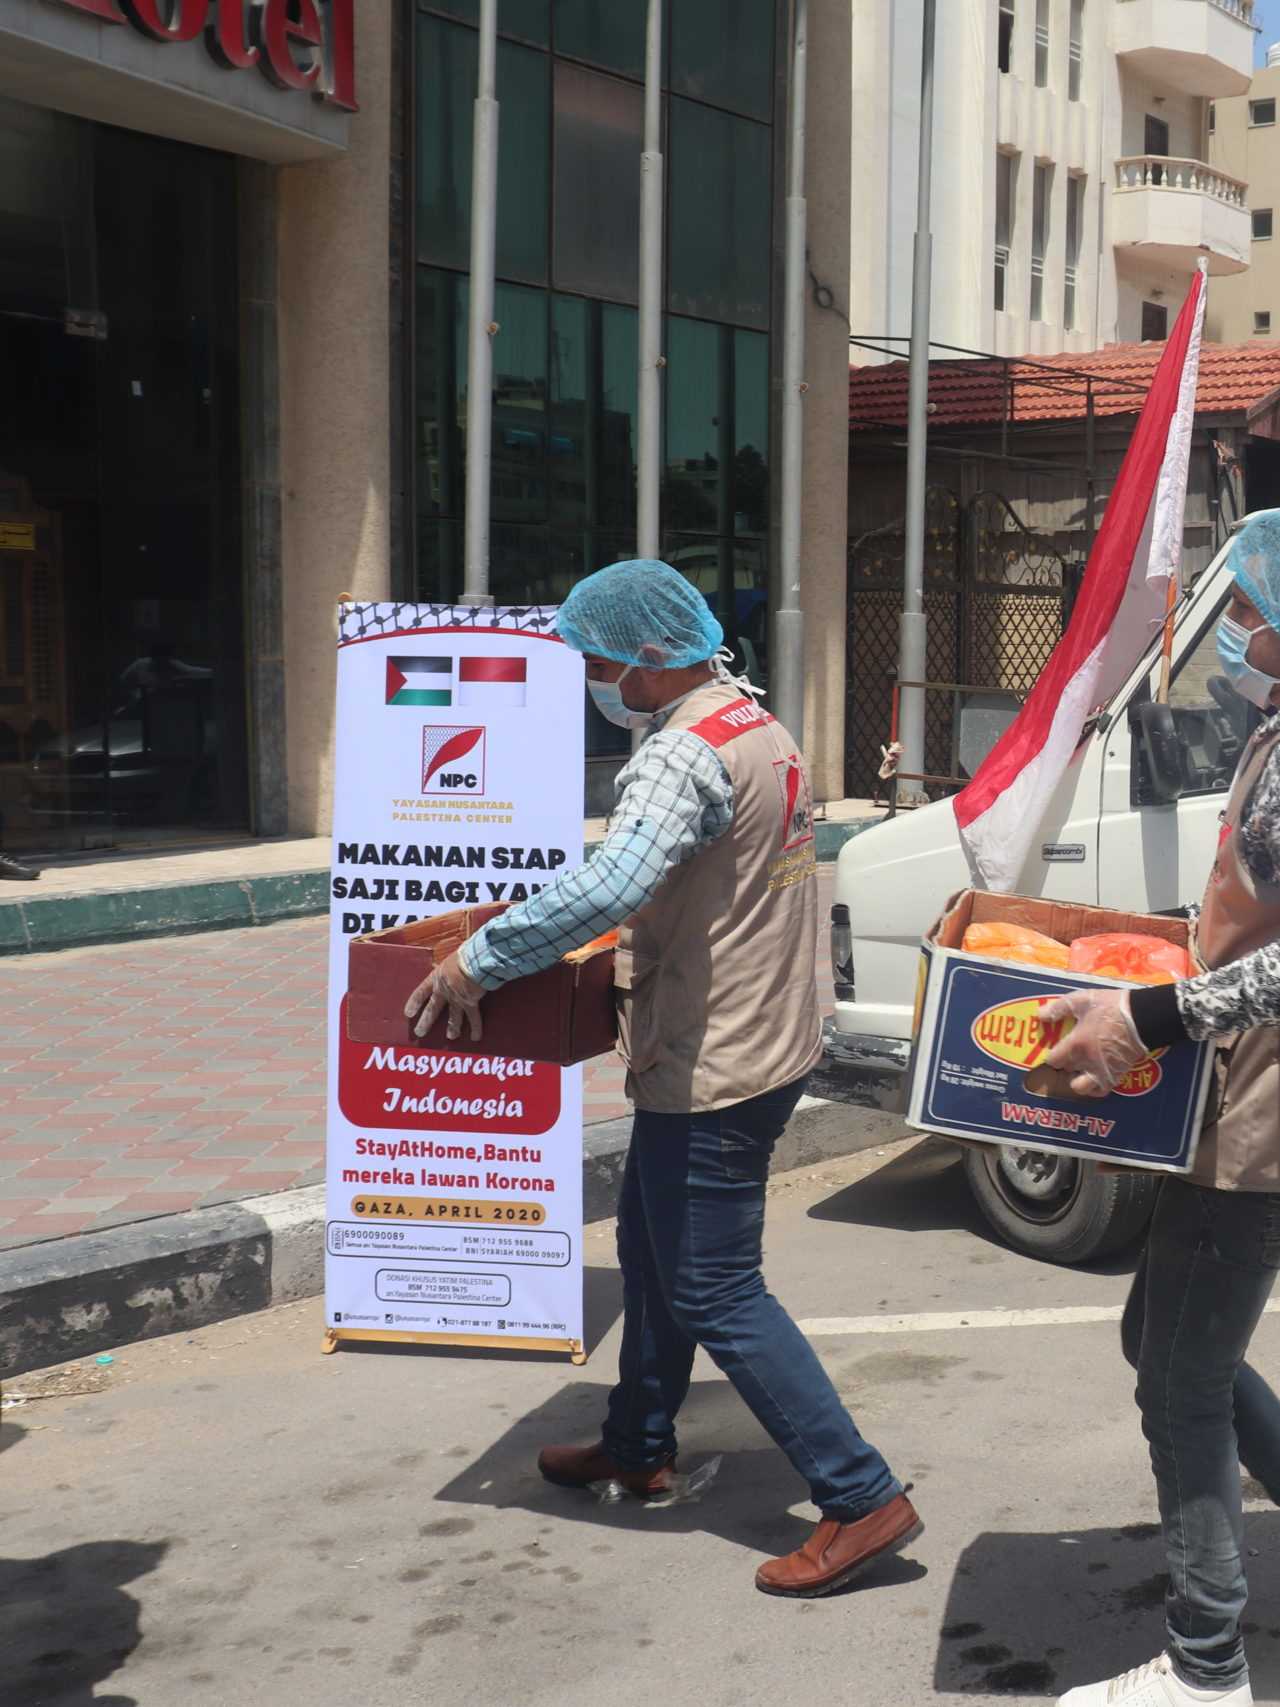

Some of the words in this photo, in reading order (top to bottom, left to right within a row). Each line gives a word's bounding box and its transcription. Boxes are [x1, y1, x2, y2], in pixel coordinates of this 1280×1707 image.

[440, 773, 477, 789] NPC
[392, 798, 446, 810] YAYASAN
[448, 800, 515, 811] NUSANTARA
[392, 812, 461, 824] PALESTINA
[467, 814, 513, 825] CENTER
[338, 842, 486, 868] MAKANAN
[492, 847, 567, 871] SIAP
[332, 878, 399, 900] SAJI
[405, 880, 479, 903] BAGI
[342, 912, 375, 934] DI
[363, 1046, 535, 1081] Masyarakat
[382, 1087, 524, 1118] Indonesia
[1001, 1101, 1116, 1138] AL-KERAM
[355, 1138, 542, 1163] StayAtHome,Bantu
[342, 1167, 415, 1186] mereka
[421, 1168, 480, 1188] lawan
[485, 1172, 555, 1192] Korona
[425, 1203, 483, 1219] APRIL
[493, 1207, 541, 1221] 2020
[344, 1229, 405, 1241] 6900090089
